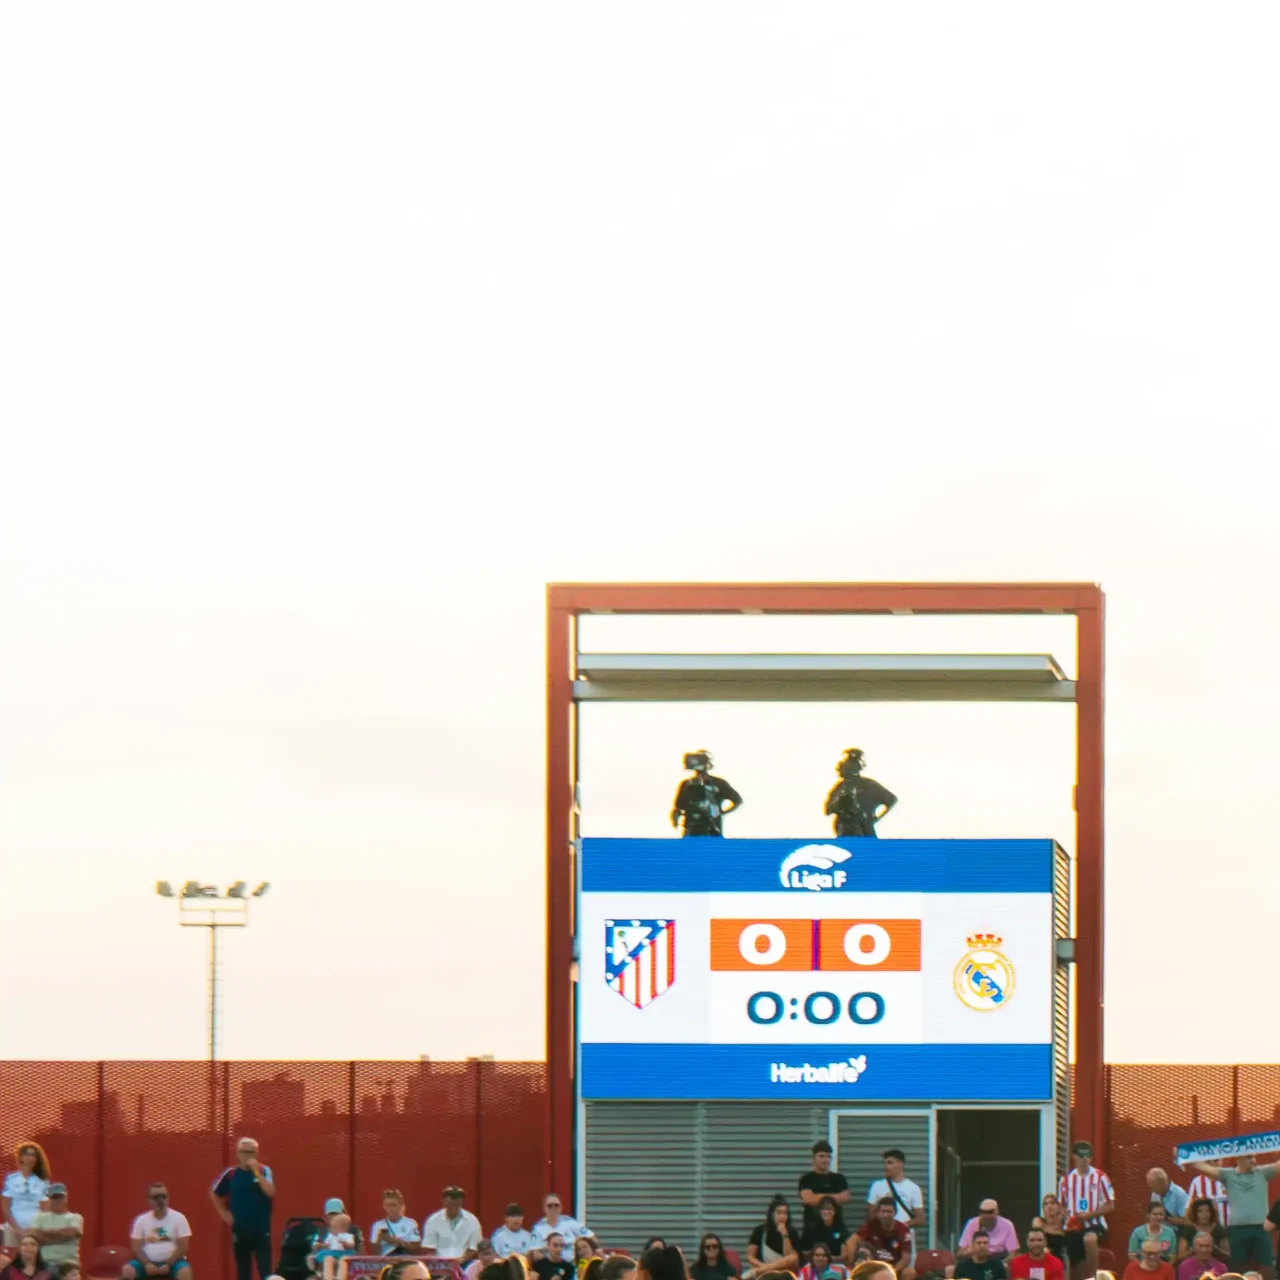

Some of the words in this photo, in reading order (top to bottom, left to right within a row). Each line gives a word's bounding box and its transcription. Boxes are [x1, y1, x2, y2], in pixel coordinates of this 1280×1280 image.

[833, 869, 847, 888] F
[739, 923, 786, 965] 0
[844, 923, 891, 965] 0
[747, 991, 885, 1025] 0:00
[770, 1062, 859, 1083] Herbalife
